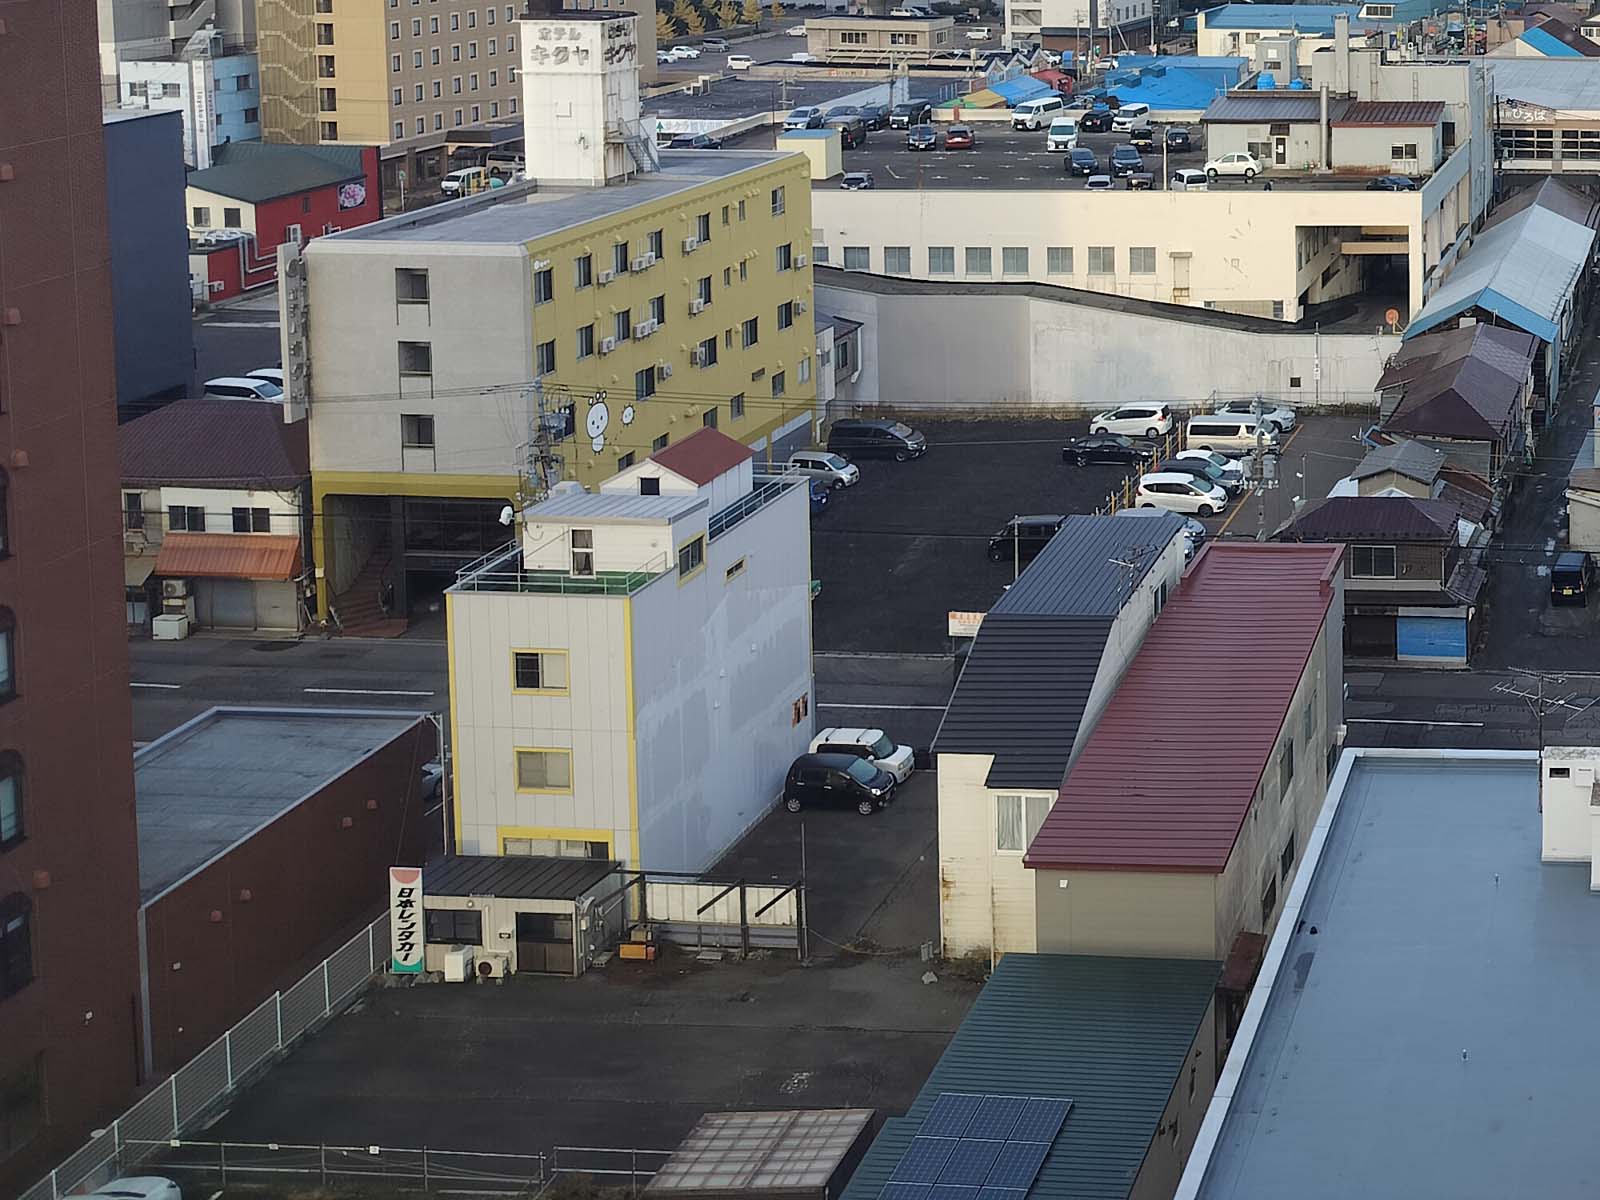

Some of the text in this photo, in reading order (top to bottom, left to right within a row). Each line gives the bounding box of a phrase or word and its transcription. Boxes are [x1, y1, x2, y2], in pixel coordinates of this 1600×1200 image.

[538, 27, 582, 41] ホテル
[530, 44, 589, 66] キクヤ
[395, 887, 417, 962] 日本レンタカー
